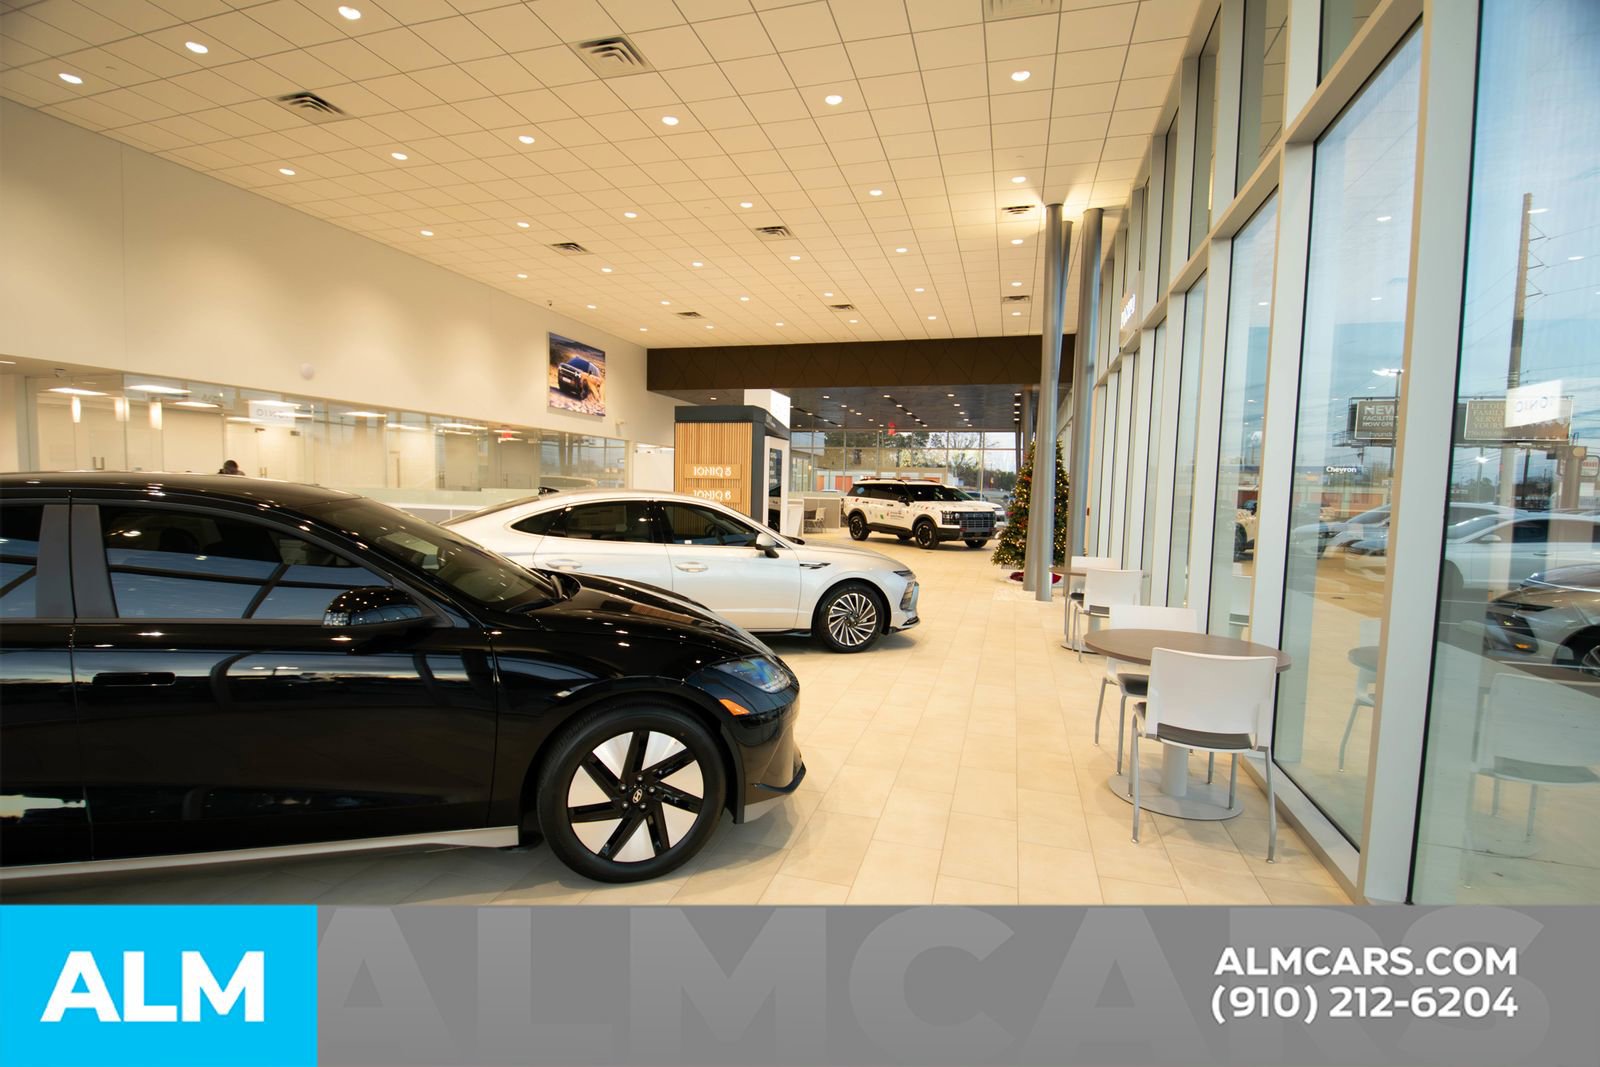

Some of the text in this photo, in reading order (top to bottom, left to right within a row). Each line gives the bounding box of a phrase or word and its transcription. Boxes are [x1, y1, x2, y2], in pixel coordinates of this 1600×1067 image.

[693, 466, 732, 478] IONIQ 5
[1326, 466, 1357, 475] Chevron
[693, 490, 723, 501] IONIQ
